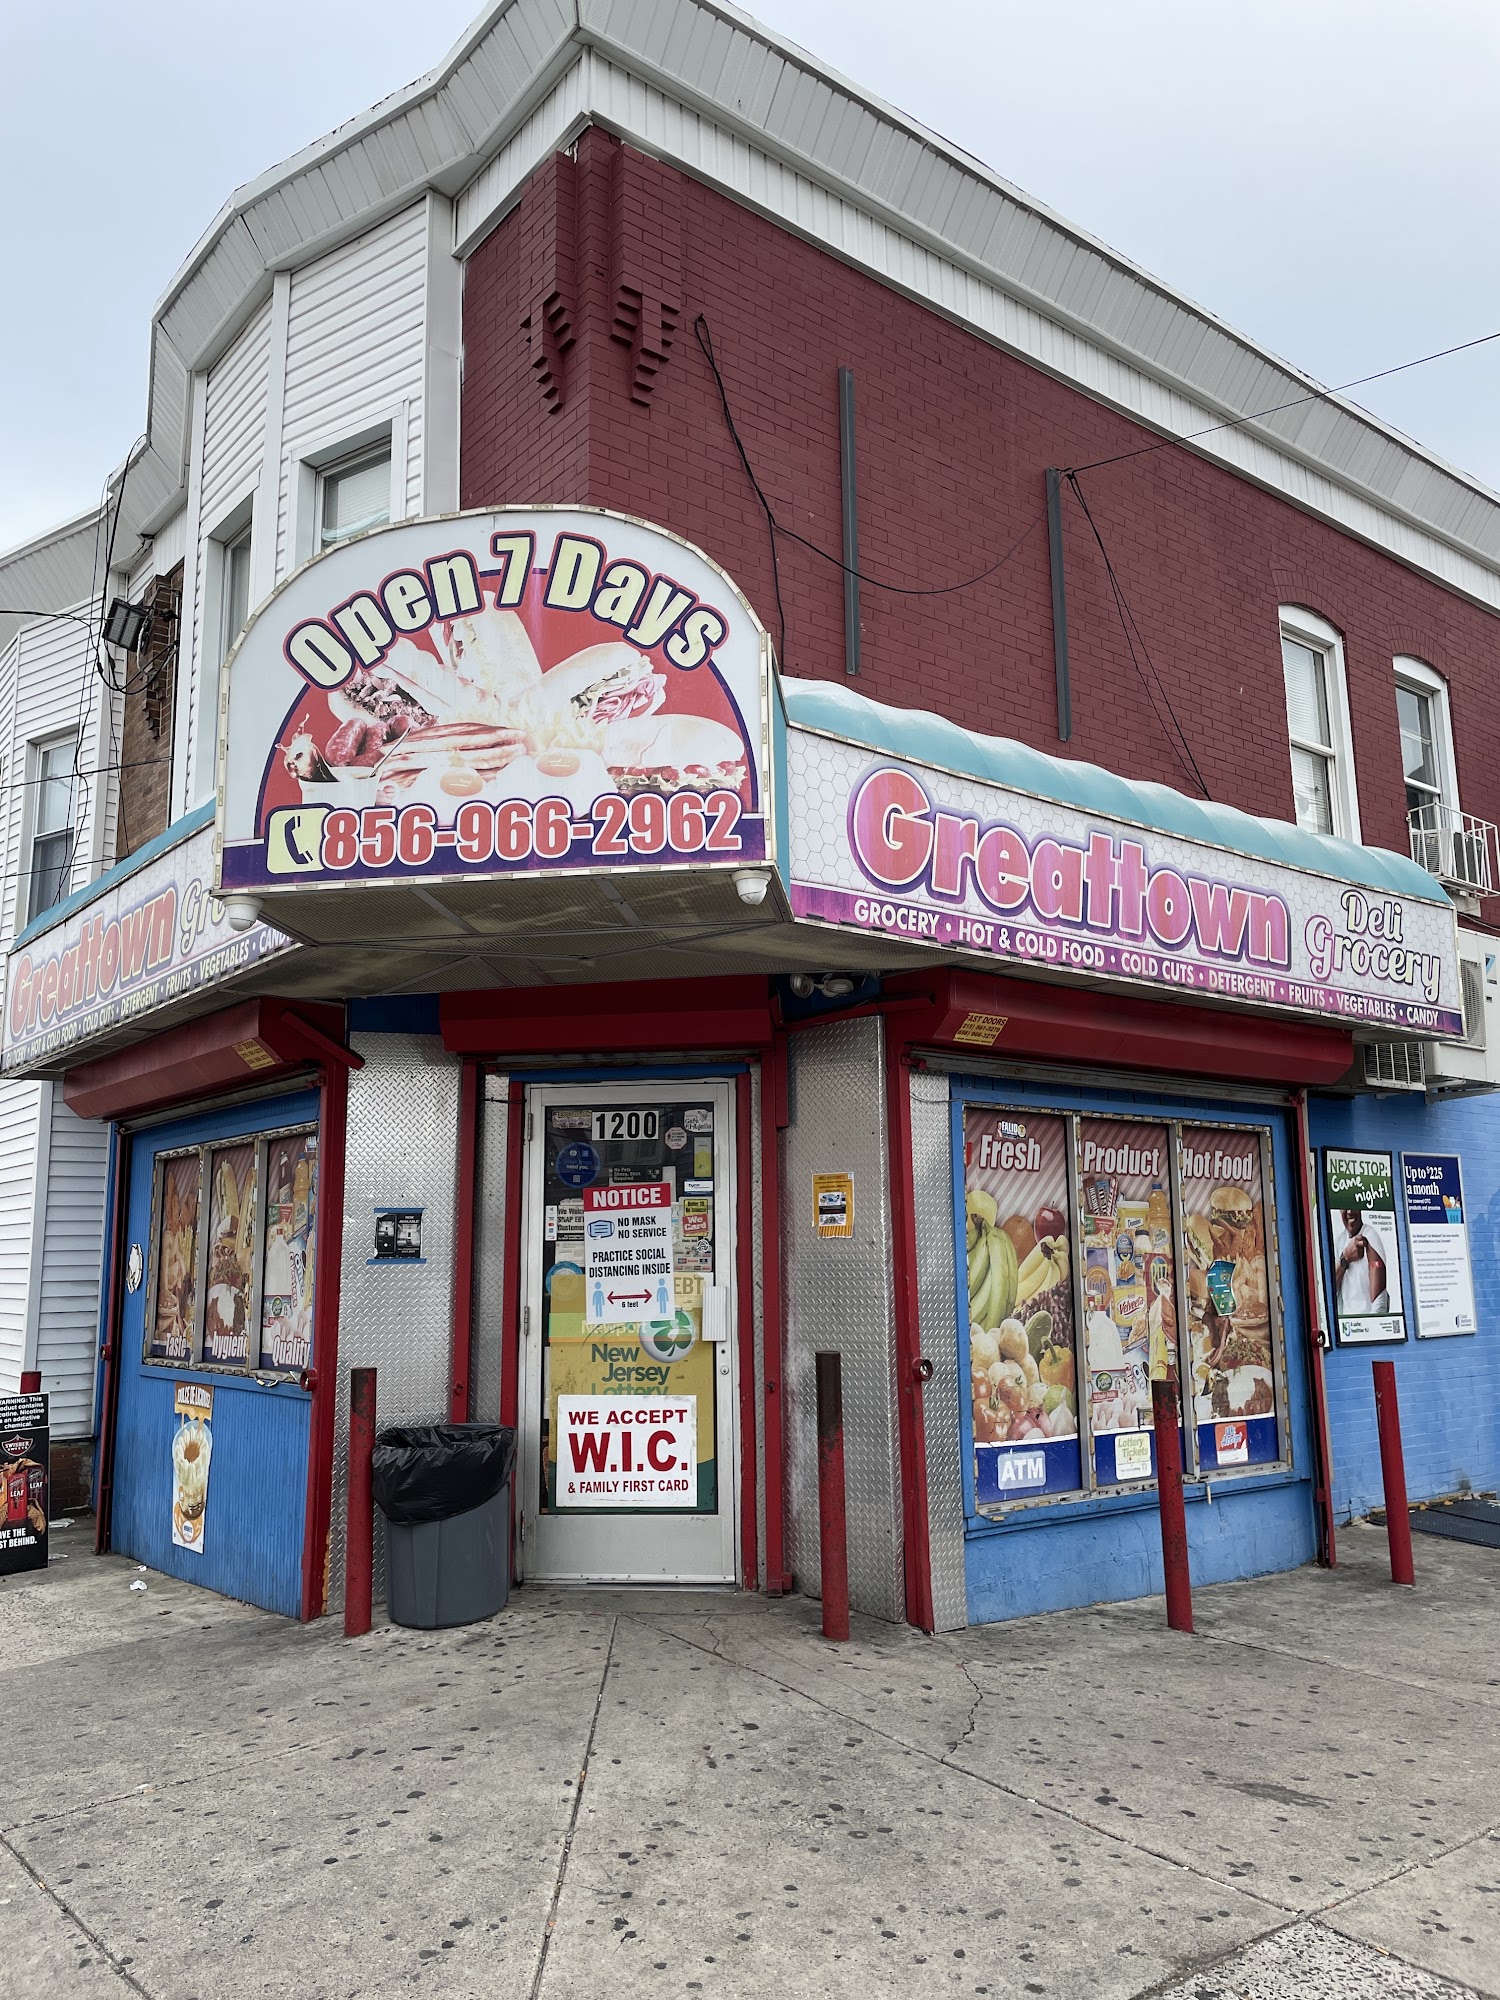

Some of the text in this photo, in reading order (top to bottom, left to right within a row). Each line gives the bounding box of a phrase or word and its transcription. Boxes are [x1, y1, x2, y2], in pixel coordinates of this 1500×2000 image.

[287, 533, 728, 689] Open 7 Days
[320, 791, 742, 871] 856-966-2962
[852, 766, 1290, 967] Greattown
[1341, 889, 1403, 943] Deli
[11, 886, 177, 1038] Greattown
[854, 899, 1439, 1026] GROCERY HOT & COLD FOOD COLD CUTS DETERGENT FRUITS VEGETABLES CANDY
[1305, 914, 1441, 1003] Grocery
[47, 1032, 61, 1049] COLD
[61, 1021, 77, 1043] FOOD
[82, 1012, 98, 1034] COLD
[100, 1004, 115, 1027] CUTS
[121, 982, 160, 1017] DETERGENT
[165, 966, 192, 996] FRUITS
[200, 938, 250, 981] VEGETABLES
[595, 1112, 657, 1139] 1200
[980, 1135, 1041, 1171] Fresh
[1083, 1141, 1160, 1176] Product
[1182, 1148, 1253, 1181] Hot Food
[1329, 1158, 1388, 1177] NEXT STOP:
[1404, 1165, 1443, 1182] Up to $225
[1331, 1175, 1363, 1192] Game
[1407, 1181, 1440, 1196] a month
[593, 1187, 662, 1208] NOTICE
[1354, 1180, 1390, 1209] night!
[618, 1216, 657, 1227] NO MASK
[687, 1216, 704, 1224] We
[618, 1227, 667, 1239] NO SERVICE
[592, 1249, 633, 1263] PRACTICE
[636, 1247, 666, 1260] SOCIAL
[589, 1263, 671, 1278] DISTANCING INSIDE
[674, 1277, 704, 1295] EBT
[165, 1332, 187, 1358] Taste
[272, 1335, 310, 1369] Quality
[591, 1343, 640, 1363] New
[602, 1362, 671, 1385] Jersey
[18, 1402, 44, 1410] contains
[20, 1408, 45, 1416] Nicotine
[4, 1420, 34, 1429] chemical.
[13, 1414, 41, 1422] addictive
[568, 1409, 688, 1426] WE ACCEPT
[5, 1441, 30, 1449] SWISHER
[1118, 1436, 1144, 1448] Lottery
[568, 1430, 688, 1474] W.I.C.
[1121, 1446, 1149, 1458] Tickets
[1001, 1457, 1043, 1482] ATM
[10, 1489, 25, 1498] LEAF
[29, 1481, 44, 1489] LEAF
[568, 1479, 689, 1494] & FAMILY FIRST CARD
[12, 1527, 26, 1537] THE
[9, 1535, 38, 1548] BEHIND.
